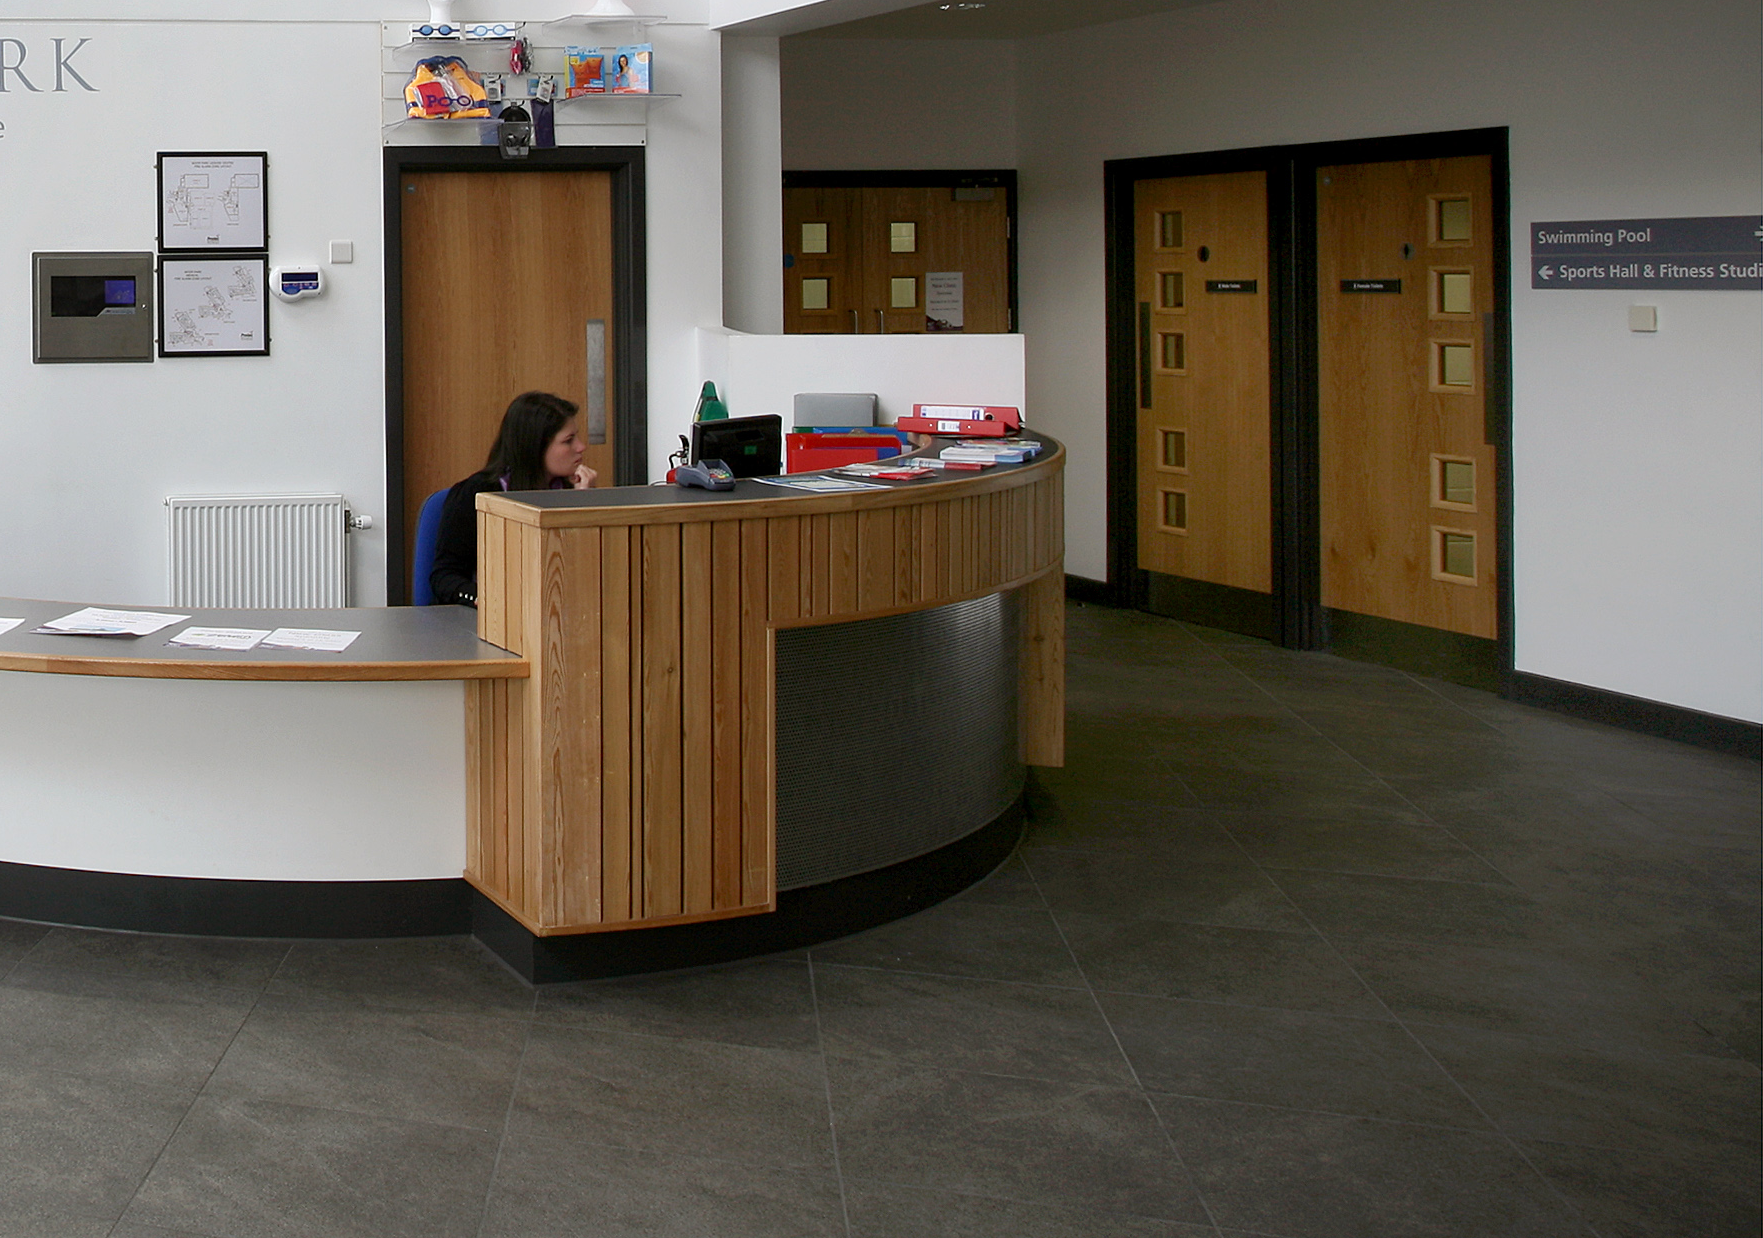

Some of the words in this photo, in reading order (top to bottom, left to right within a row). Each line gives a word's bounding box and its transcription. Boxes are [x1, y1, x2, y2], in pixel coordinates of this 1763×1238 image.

[1538, 229, 1614, 246] Swimming
[1617, 227, 1651, 243] Pool
[1559, 265, 1606, 281] Sports
[1609, 264, 1638, 278] Hall
[1643, 265, 1655, 278] &
[1659, 264, 1715, 279] Fitness
